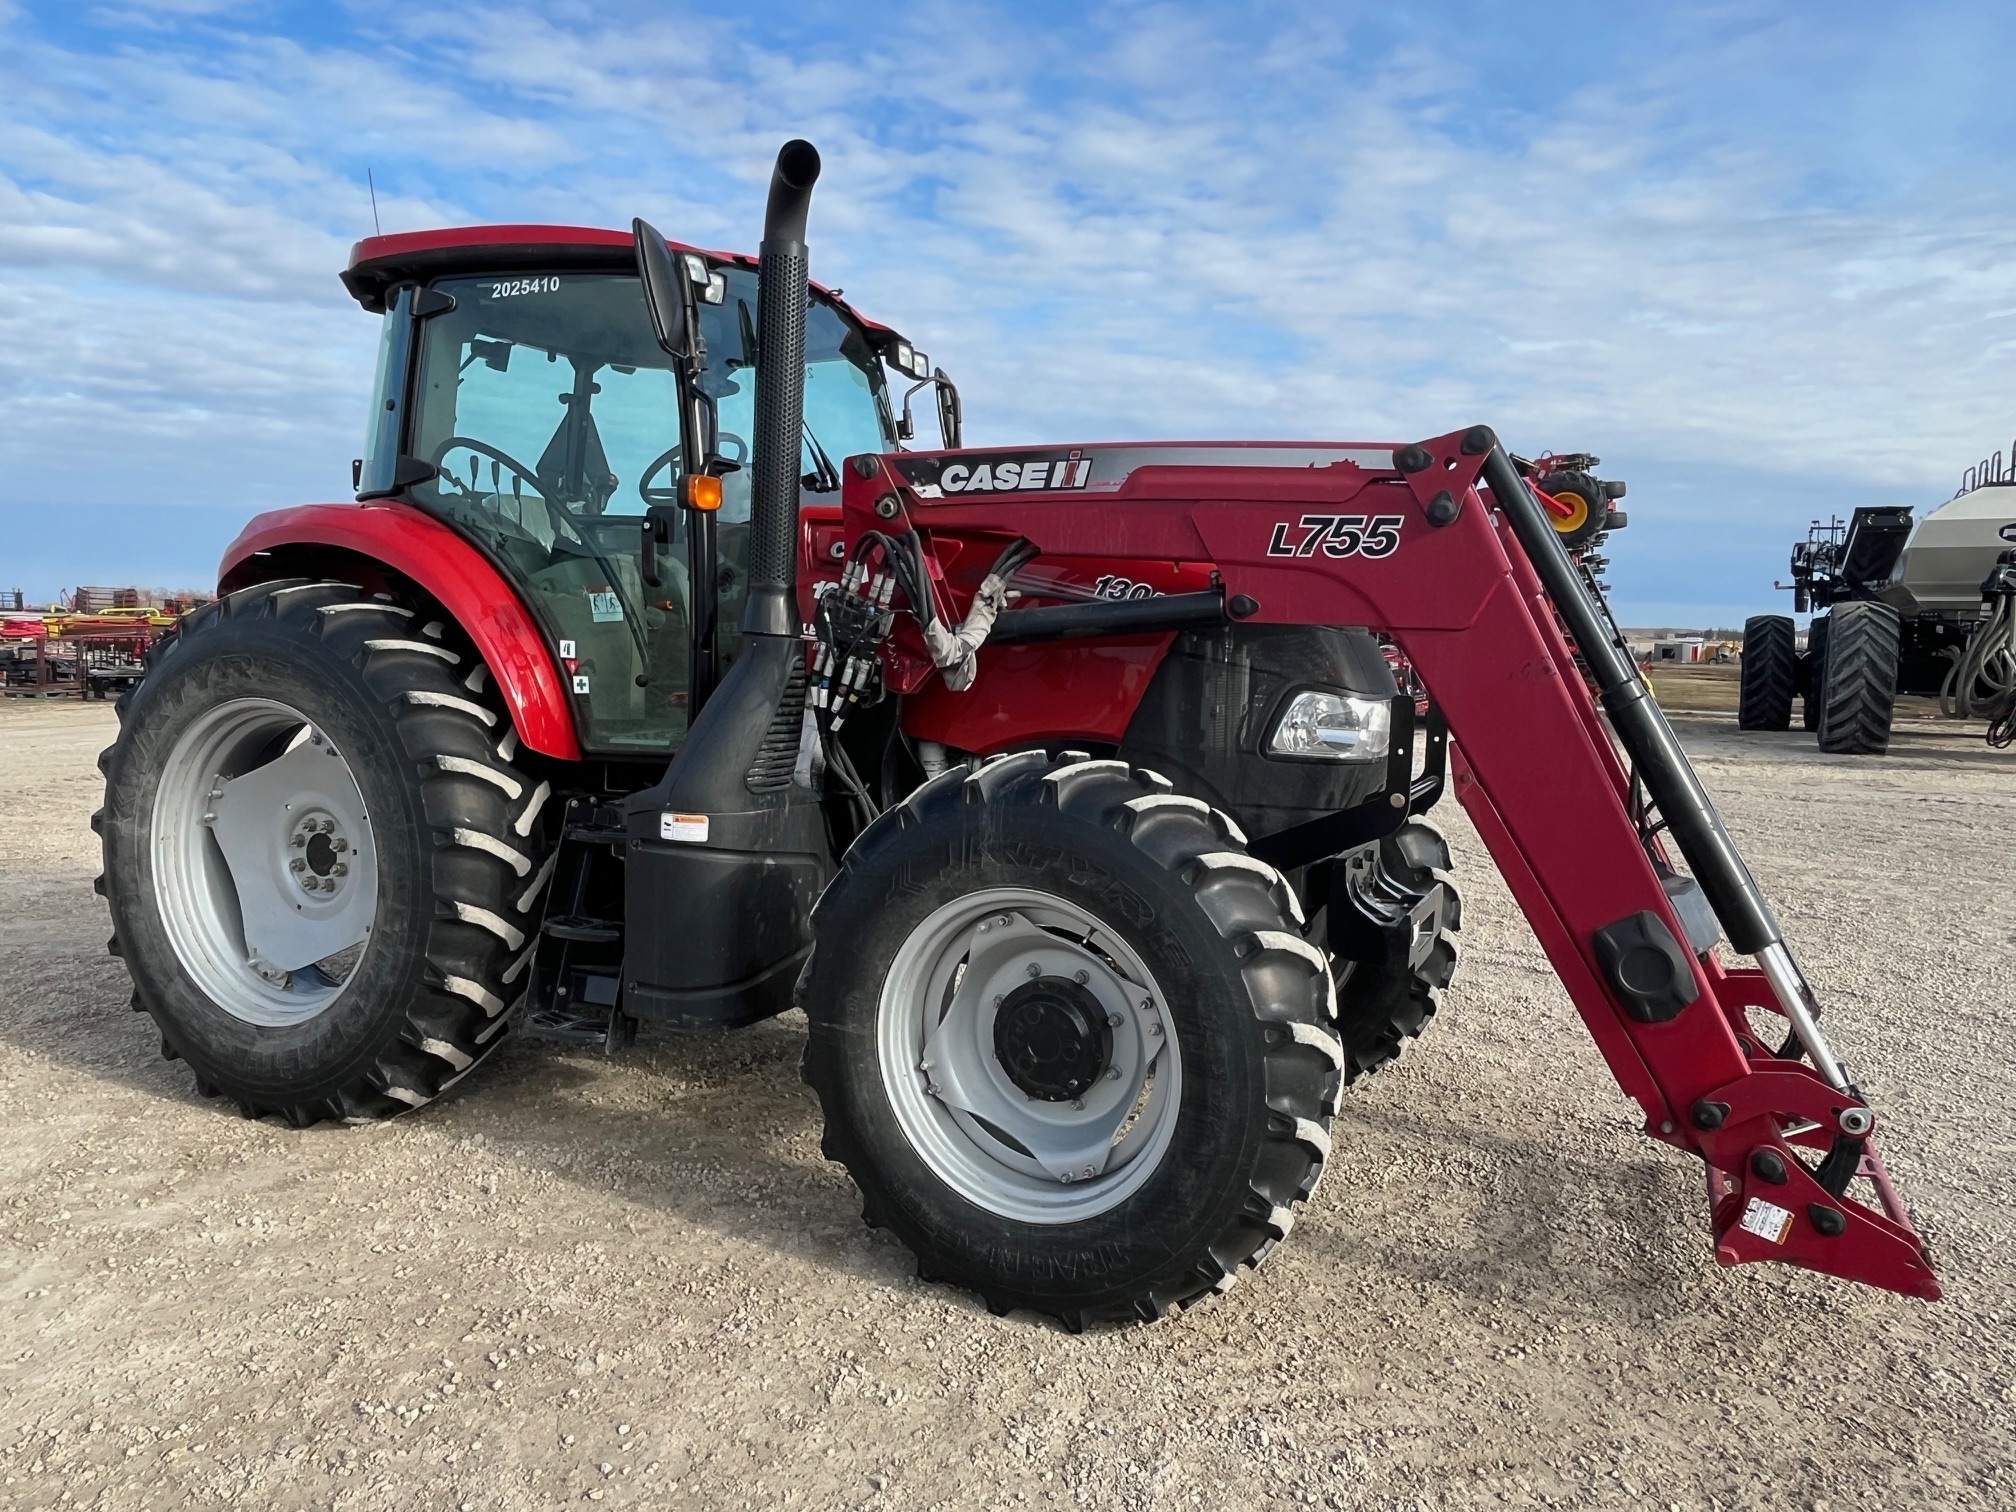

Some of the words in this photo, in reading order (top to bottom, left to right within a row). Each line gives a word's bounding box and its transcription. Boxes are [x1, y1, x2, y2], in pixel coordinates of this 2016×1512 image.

[491, 276, 560, 298] 2025410
[940, 461, 1050, 492] CASE
[1267, 514, 1405, 559] L755
